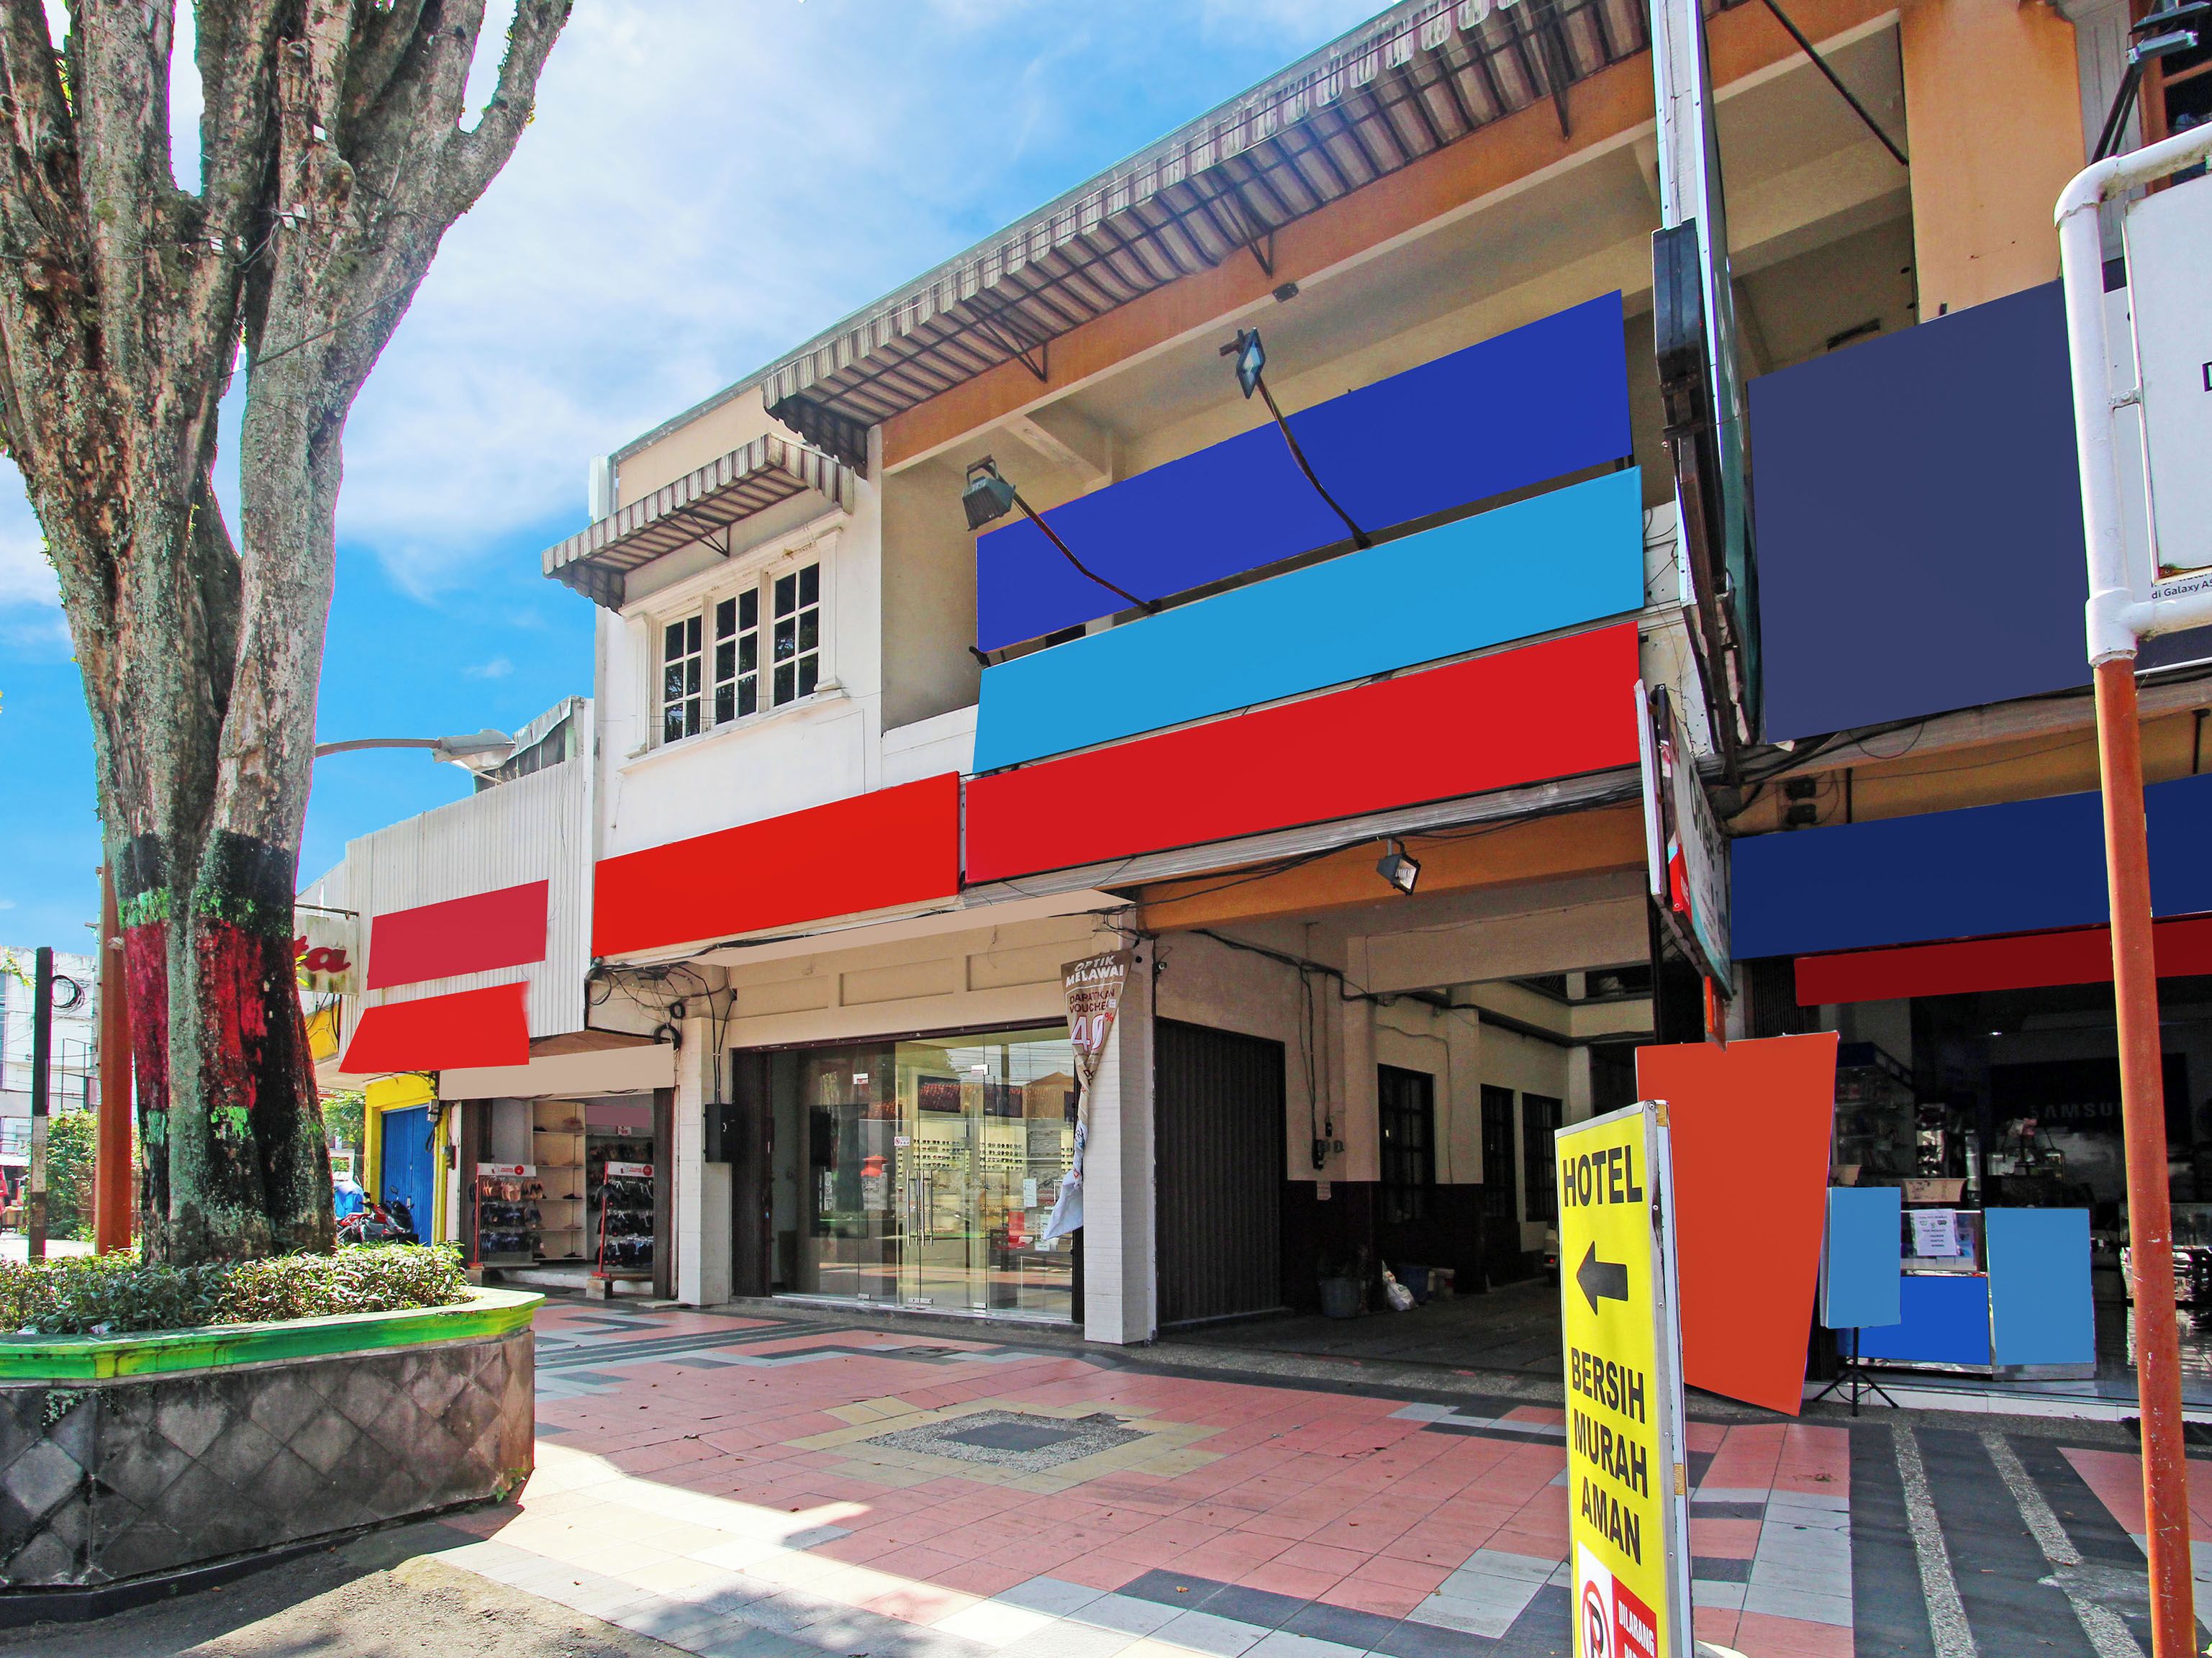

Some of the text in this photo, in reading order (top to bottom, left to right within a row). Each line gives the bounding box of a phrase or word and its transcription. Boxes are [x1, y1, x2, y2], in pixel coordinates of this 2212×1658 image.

[2152, 591, 2161, 599] di
[2164, 584, 2200, 597] Galaxy
[293, 935, 351, 971] ta
[1066, 964, 1124, 987] MELAWAI
[1074, 955, 1115, 971] OPTIK
[2029, 1101, 2122, 1118] SAMSU
[1563, 1145, 1642, 1207] HOTEL
[1572, 1347, 1645, 1424] BERSIH
[1574, 1408, 1648, 1499] MURAH
[1582, 1476, 1641, 1566] AMAN
[1618, 1599, 1655, 1658] DILARANG
